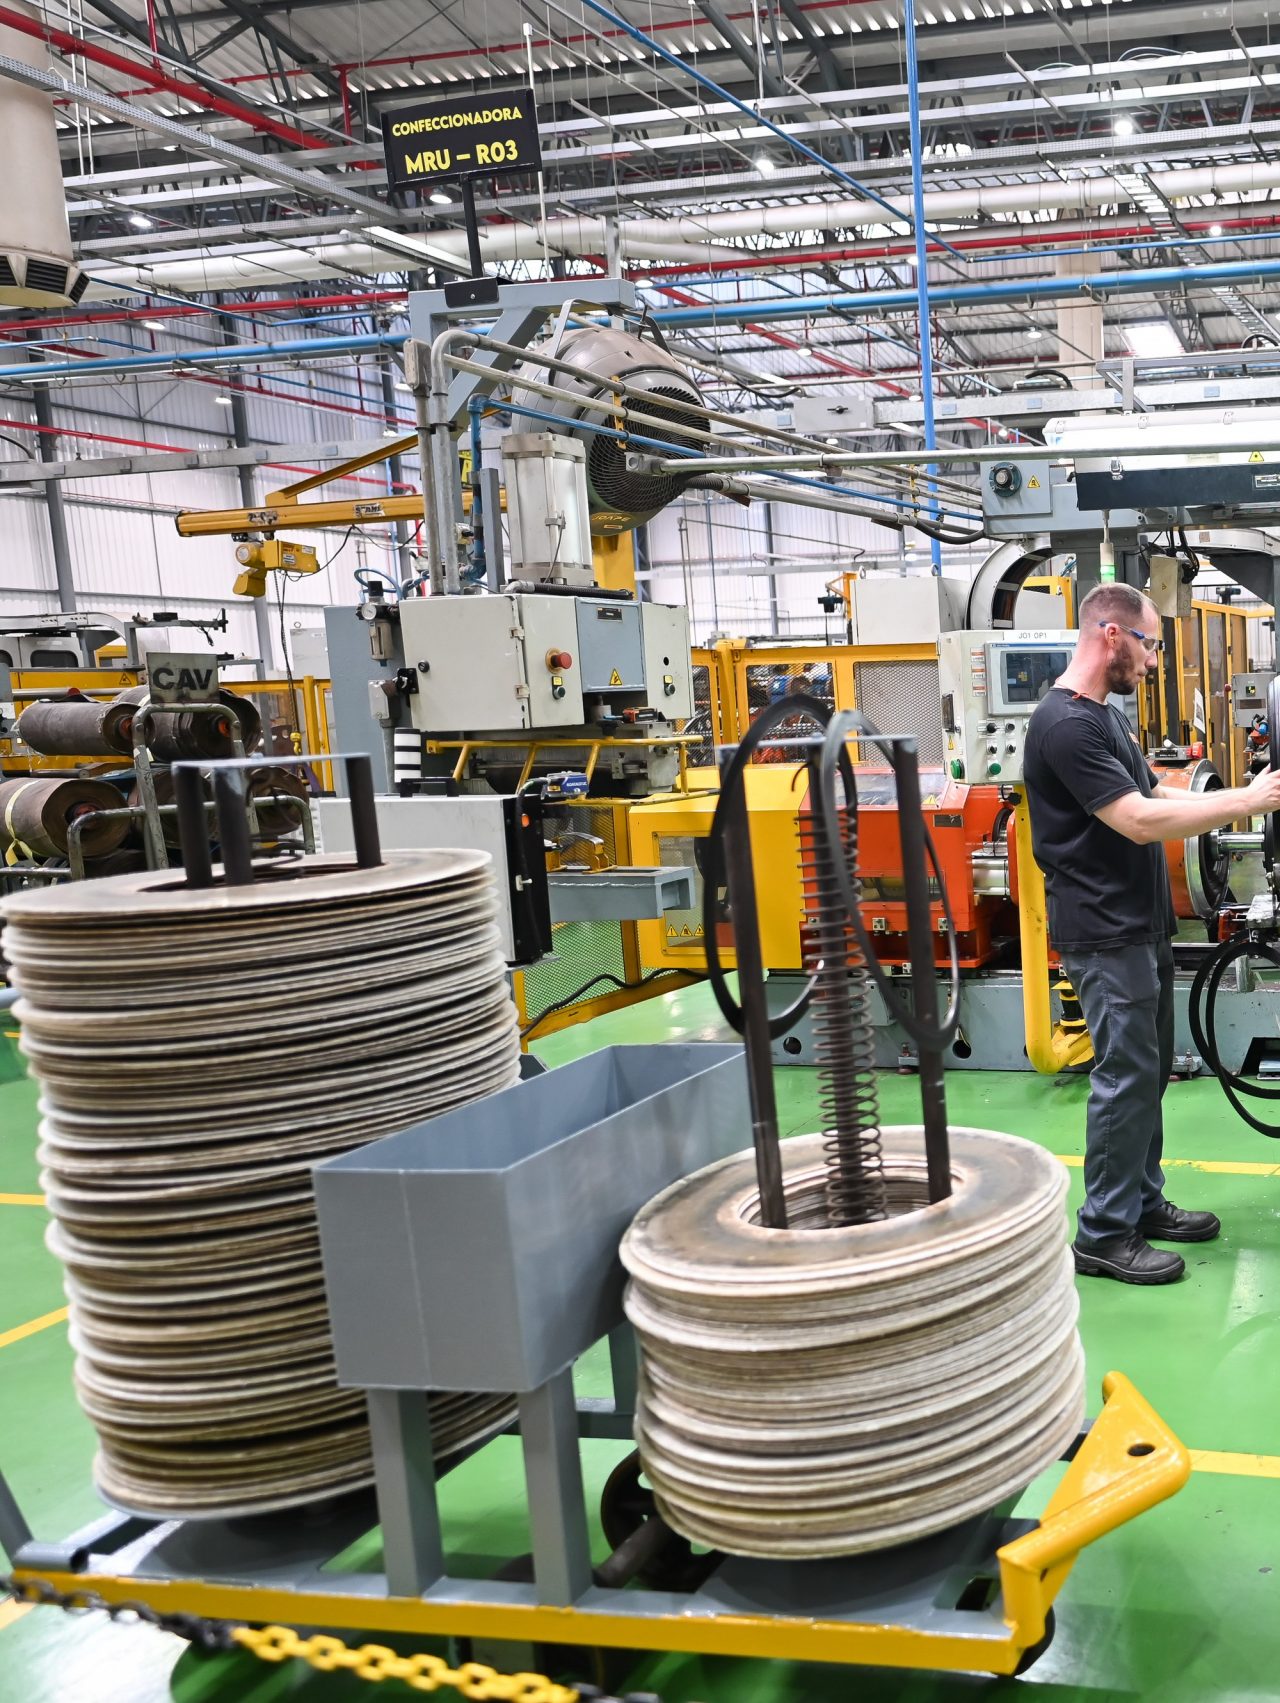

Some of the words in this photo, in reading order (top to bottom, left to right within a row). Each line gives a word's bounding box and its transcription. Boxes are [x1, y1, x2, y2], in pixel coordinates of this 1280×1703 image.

[392, 106, 523, 137] CONFECCIONADORA
[404, 148, 451, 175] MRU
[153, 667, 213, 691] CAV
